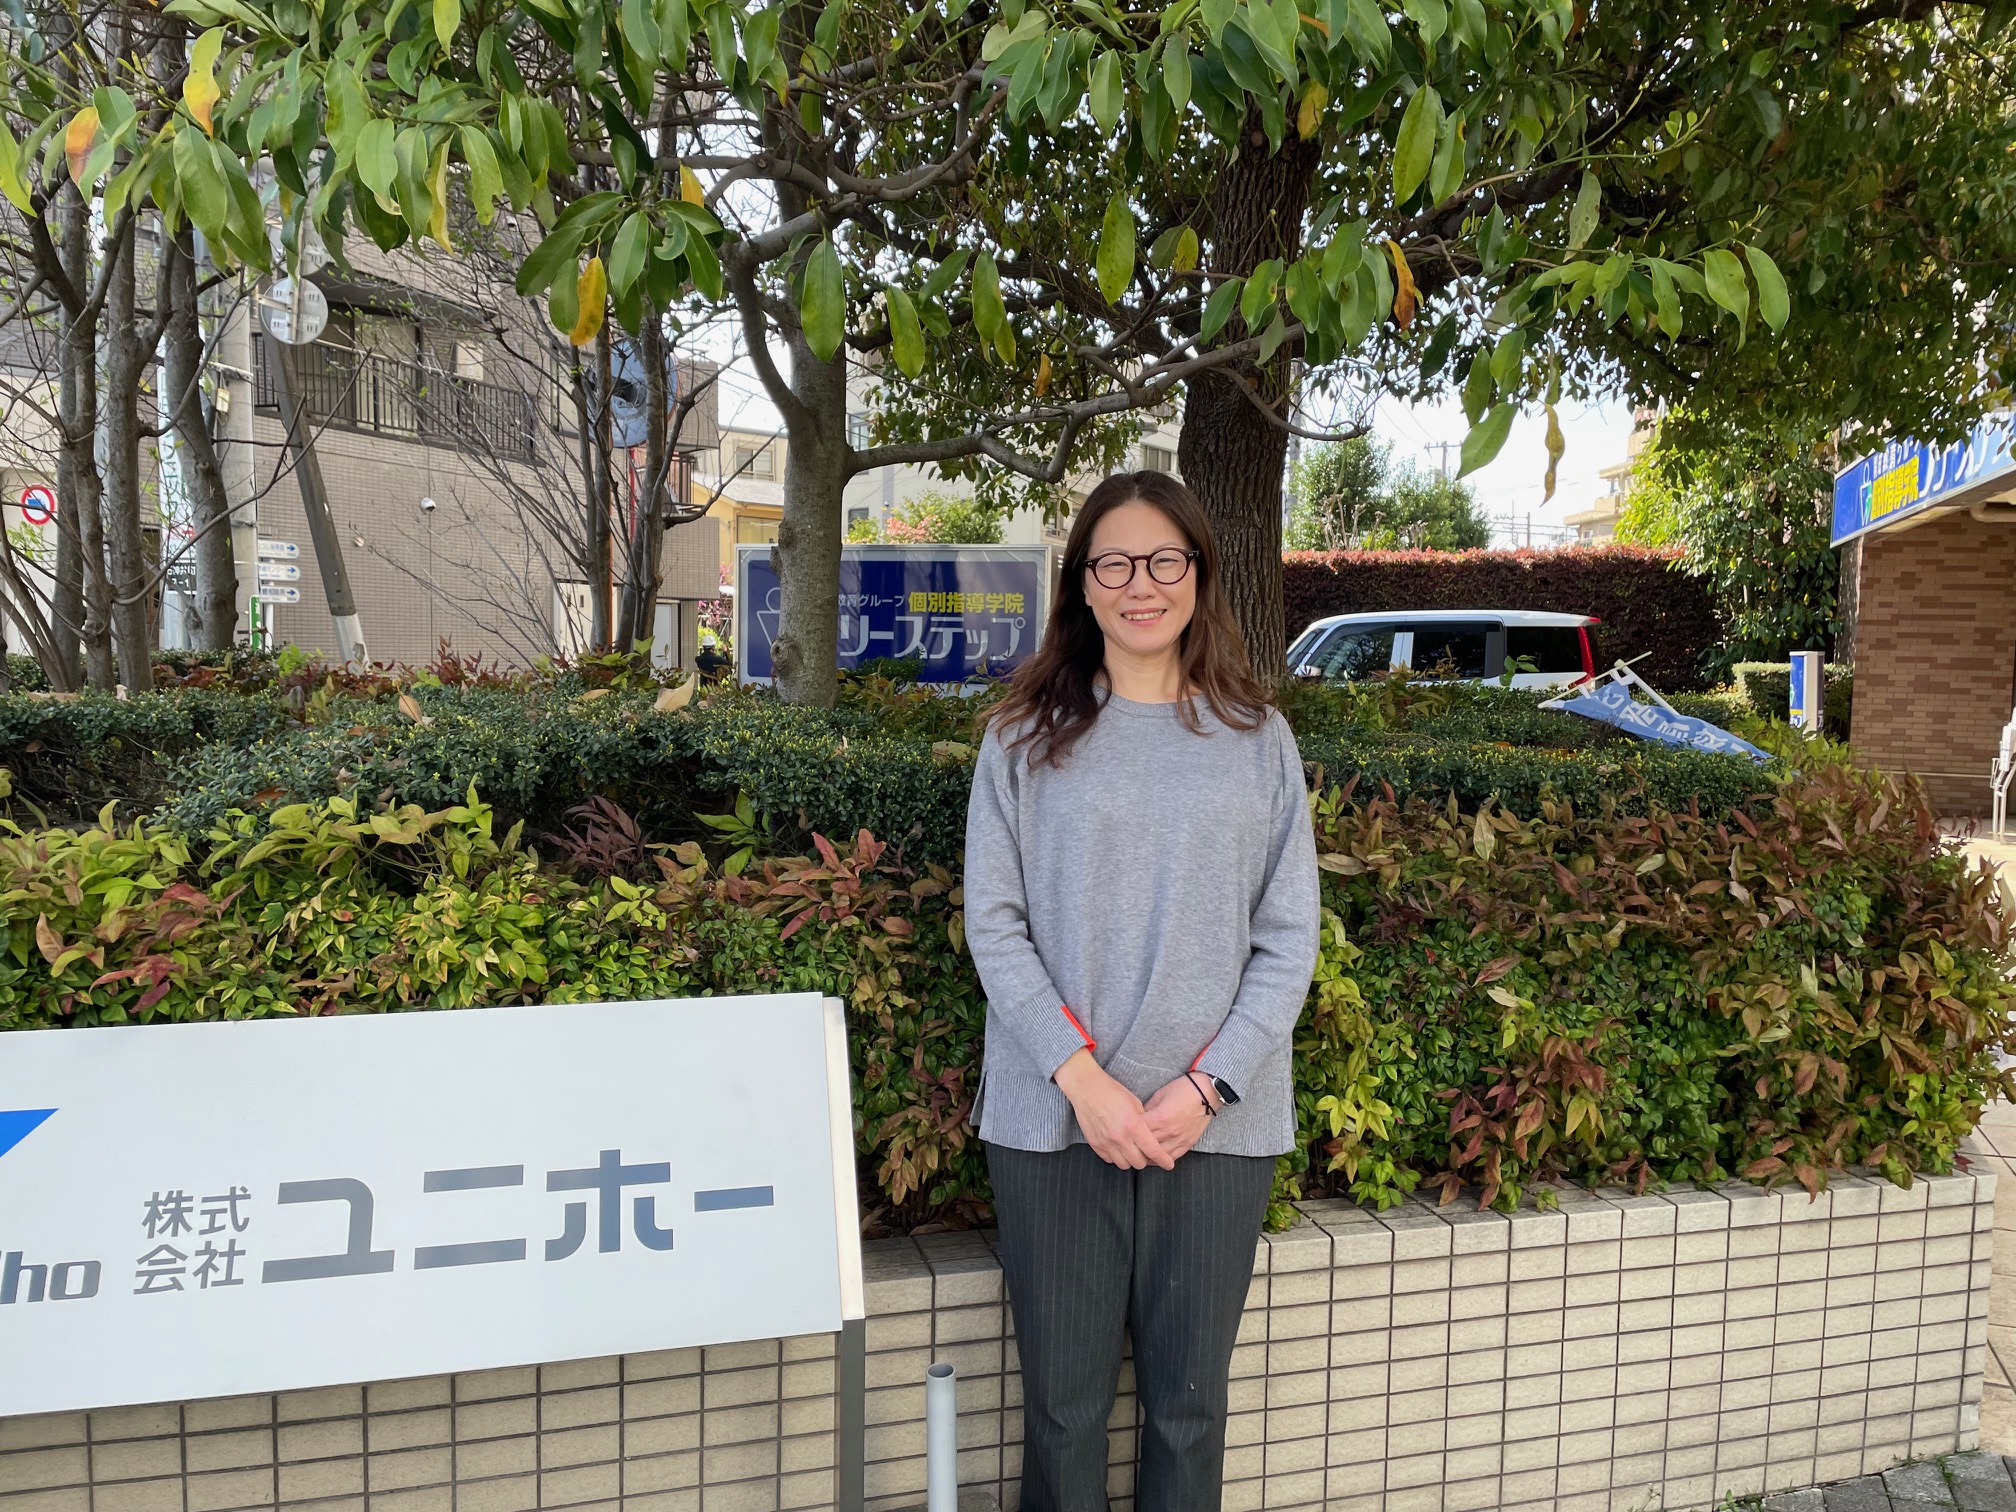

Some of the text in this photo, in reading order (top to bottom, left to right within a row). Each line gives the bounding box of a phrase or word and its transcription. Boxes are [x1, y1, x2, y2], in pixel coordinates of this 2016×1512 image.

[908, 591, 1025, 614] 個別指導学院
[839, 614, 1026, 661] リーステップ
[261, 1148, 775, 1284] ユニホー
[0, 1250, 102, 1305] ho
